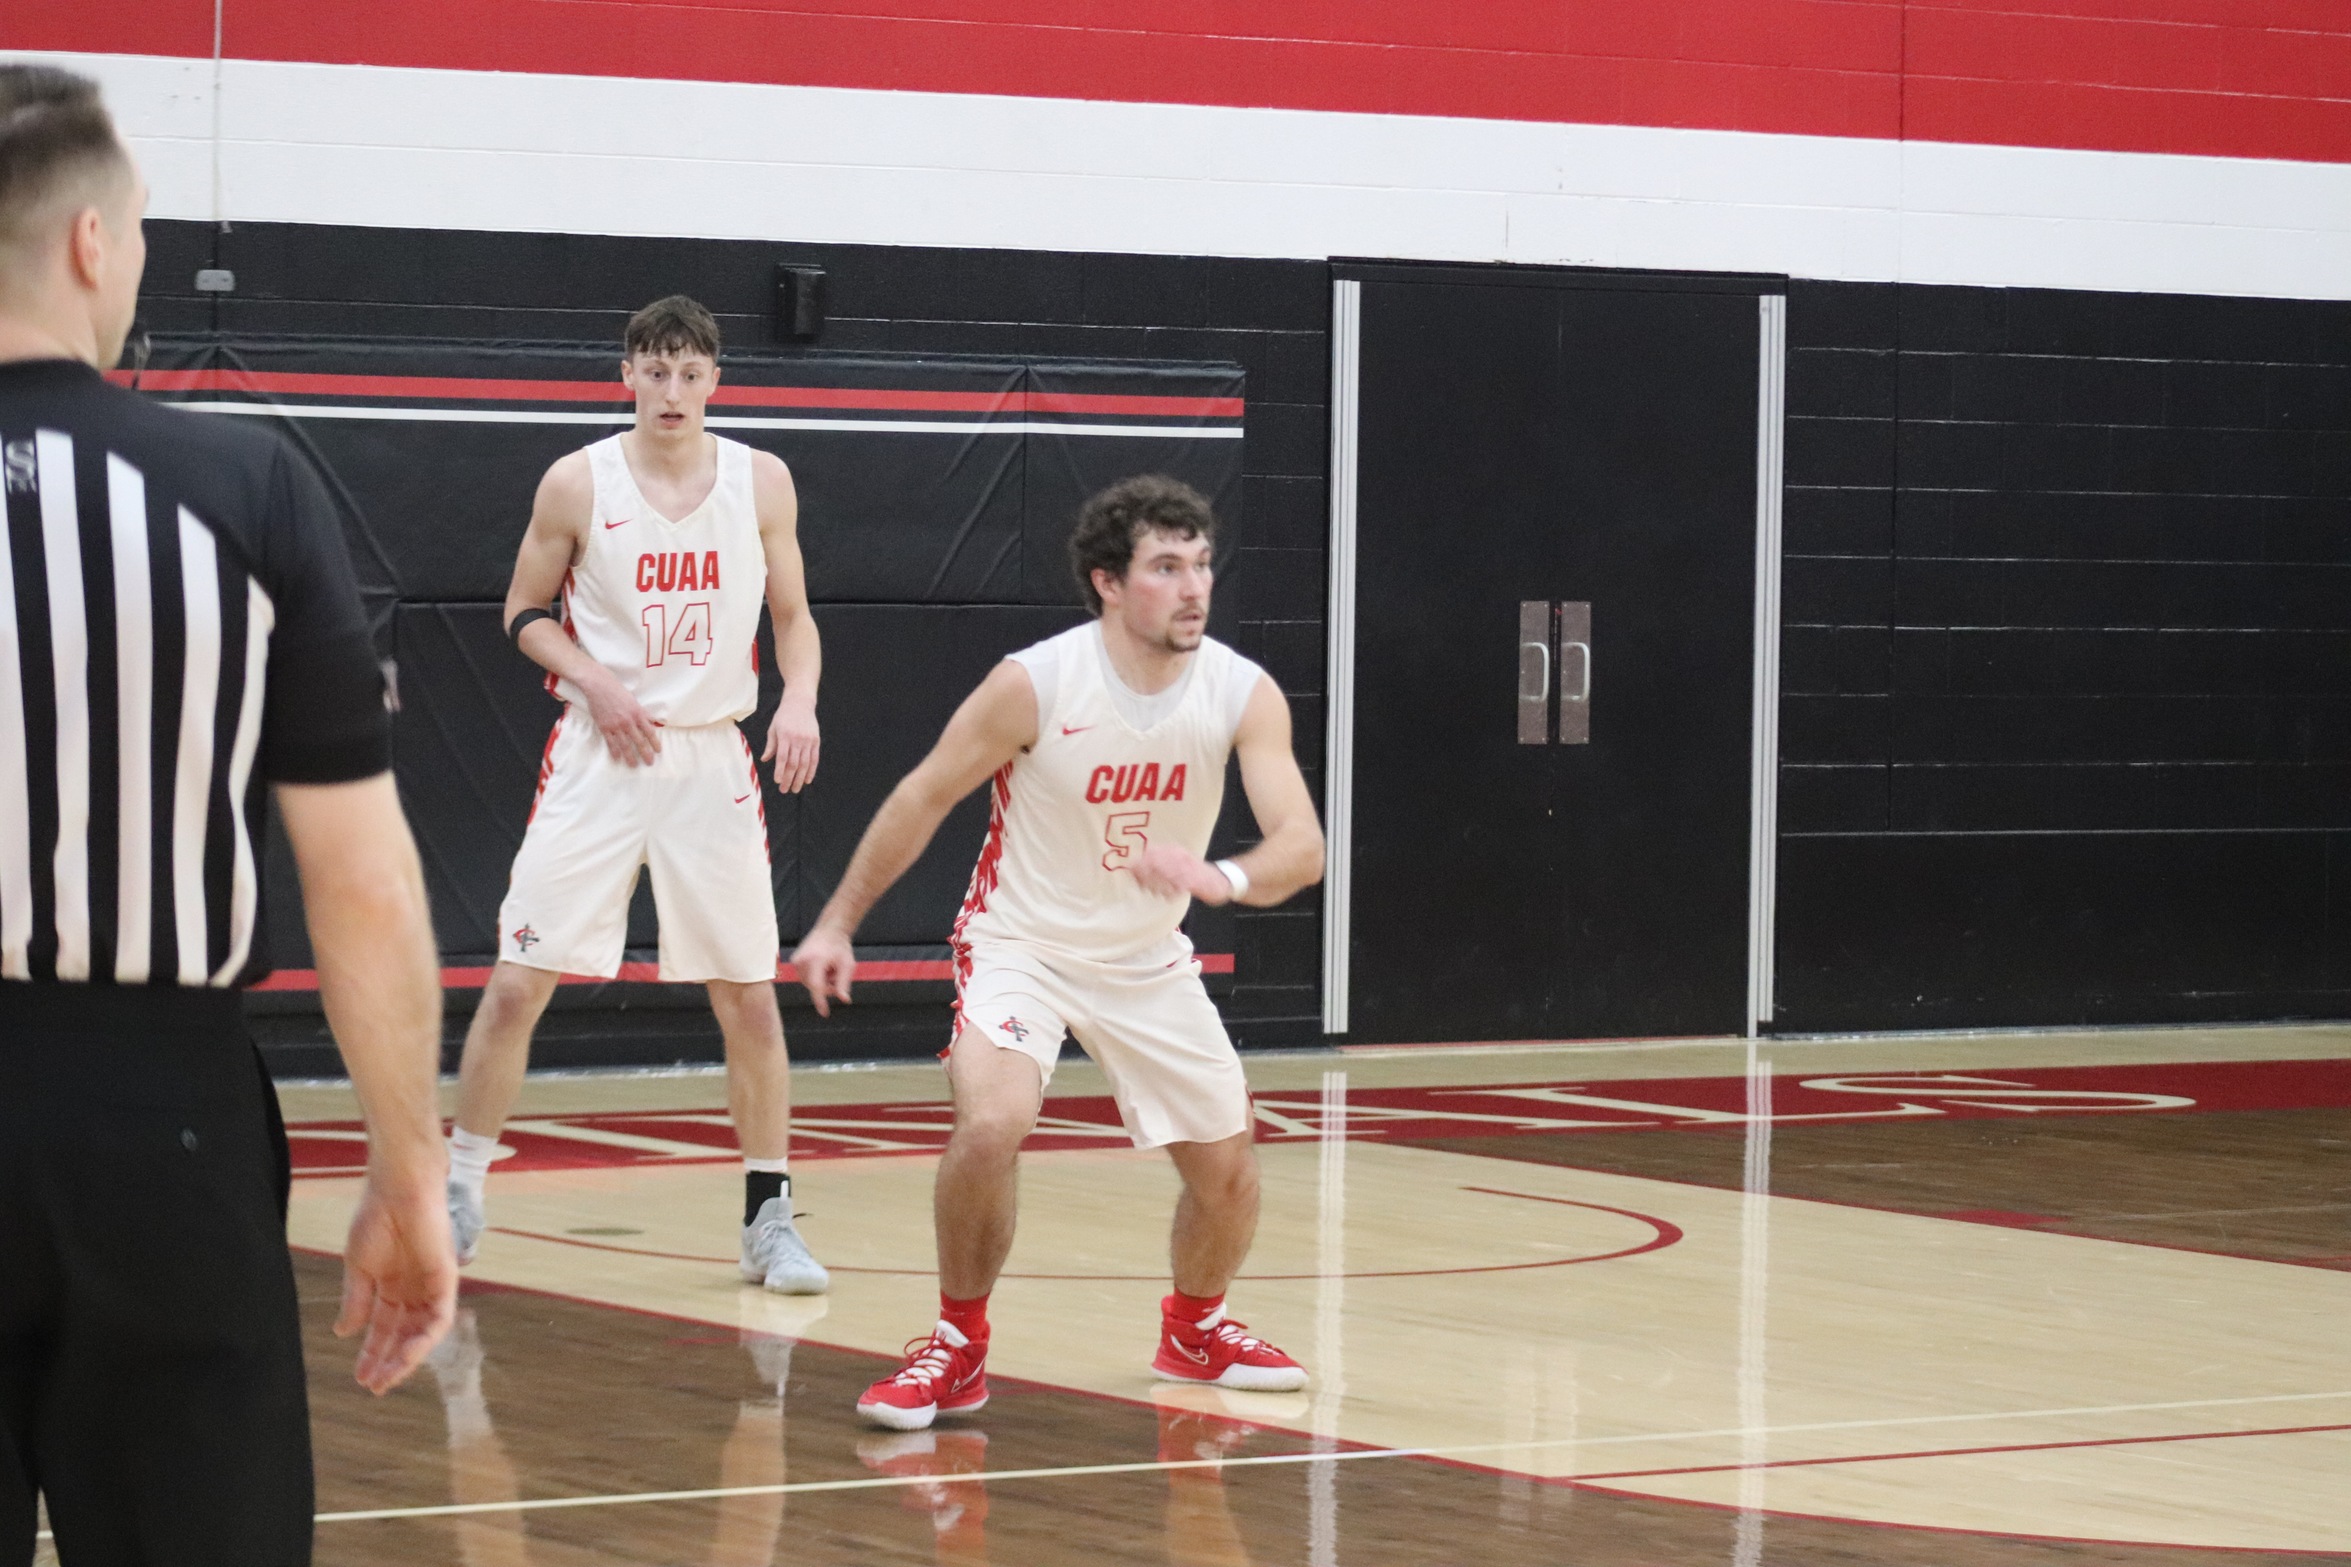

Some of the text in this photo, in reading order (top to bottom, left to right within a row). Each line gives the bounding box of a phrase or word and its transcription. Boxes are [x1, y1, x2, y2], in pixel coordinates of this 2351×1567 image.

[635, 550, 720, 593] CUAA
[642, 601, 713, 669] 14
[1084, 762, 1188, 804] CUAA
[1101, 810, 1151, 872] 5
